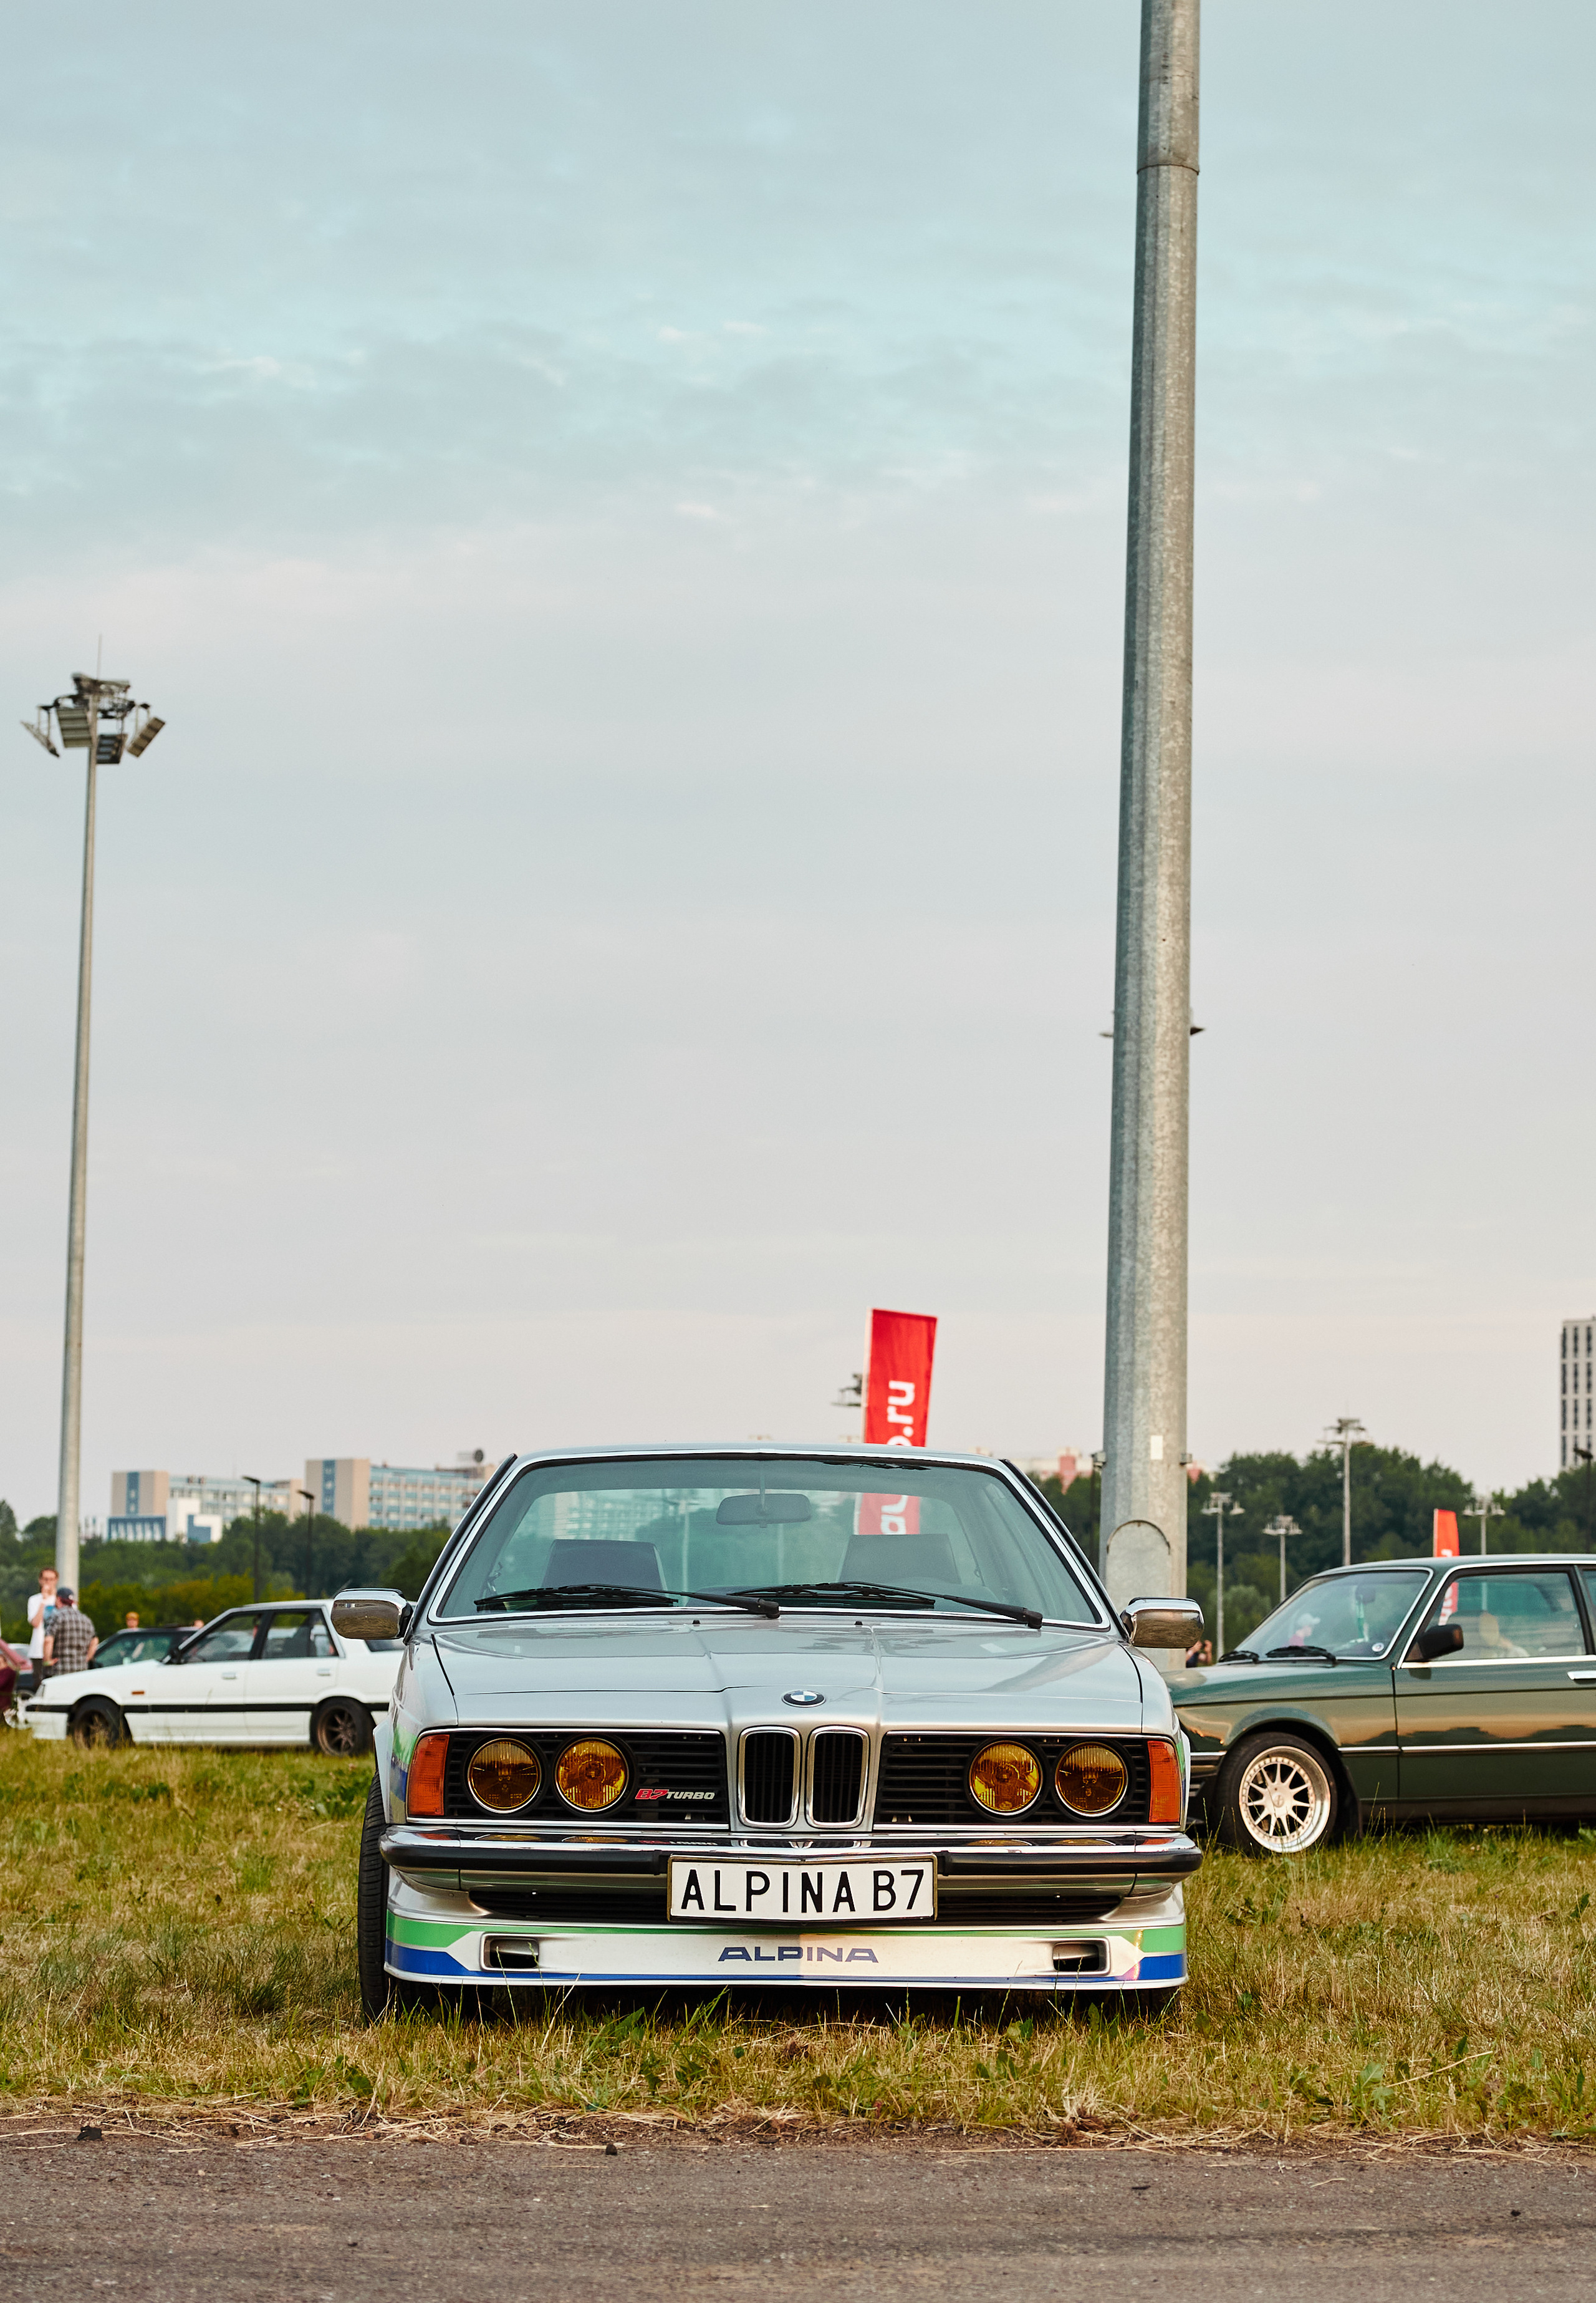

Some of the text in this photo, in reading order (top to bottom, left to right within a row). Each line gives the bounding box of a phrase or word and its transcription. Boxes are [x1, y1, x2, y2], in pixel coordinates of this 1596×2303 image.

[681, 1869, 924, 1913] ALPINA B7
[718, 1946, 879, 1963] ALPINA
